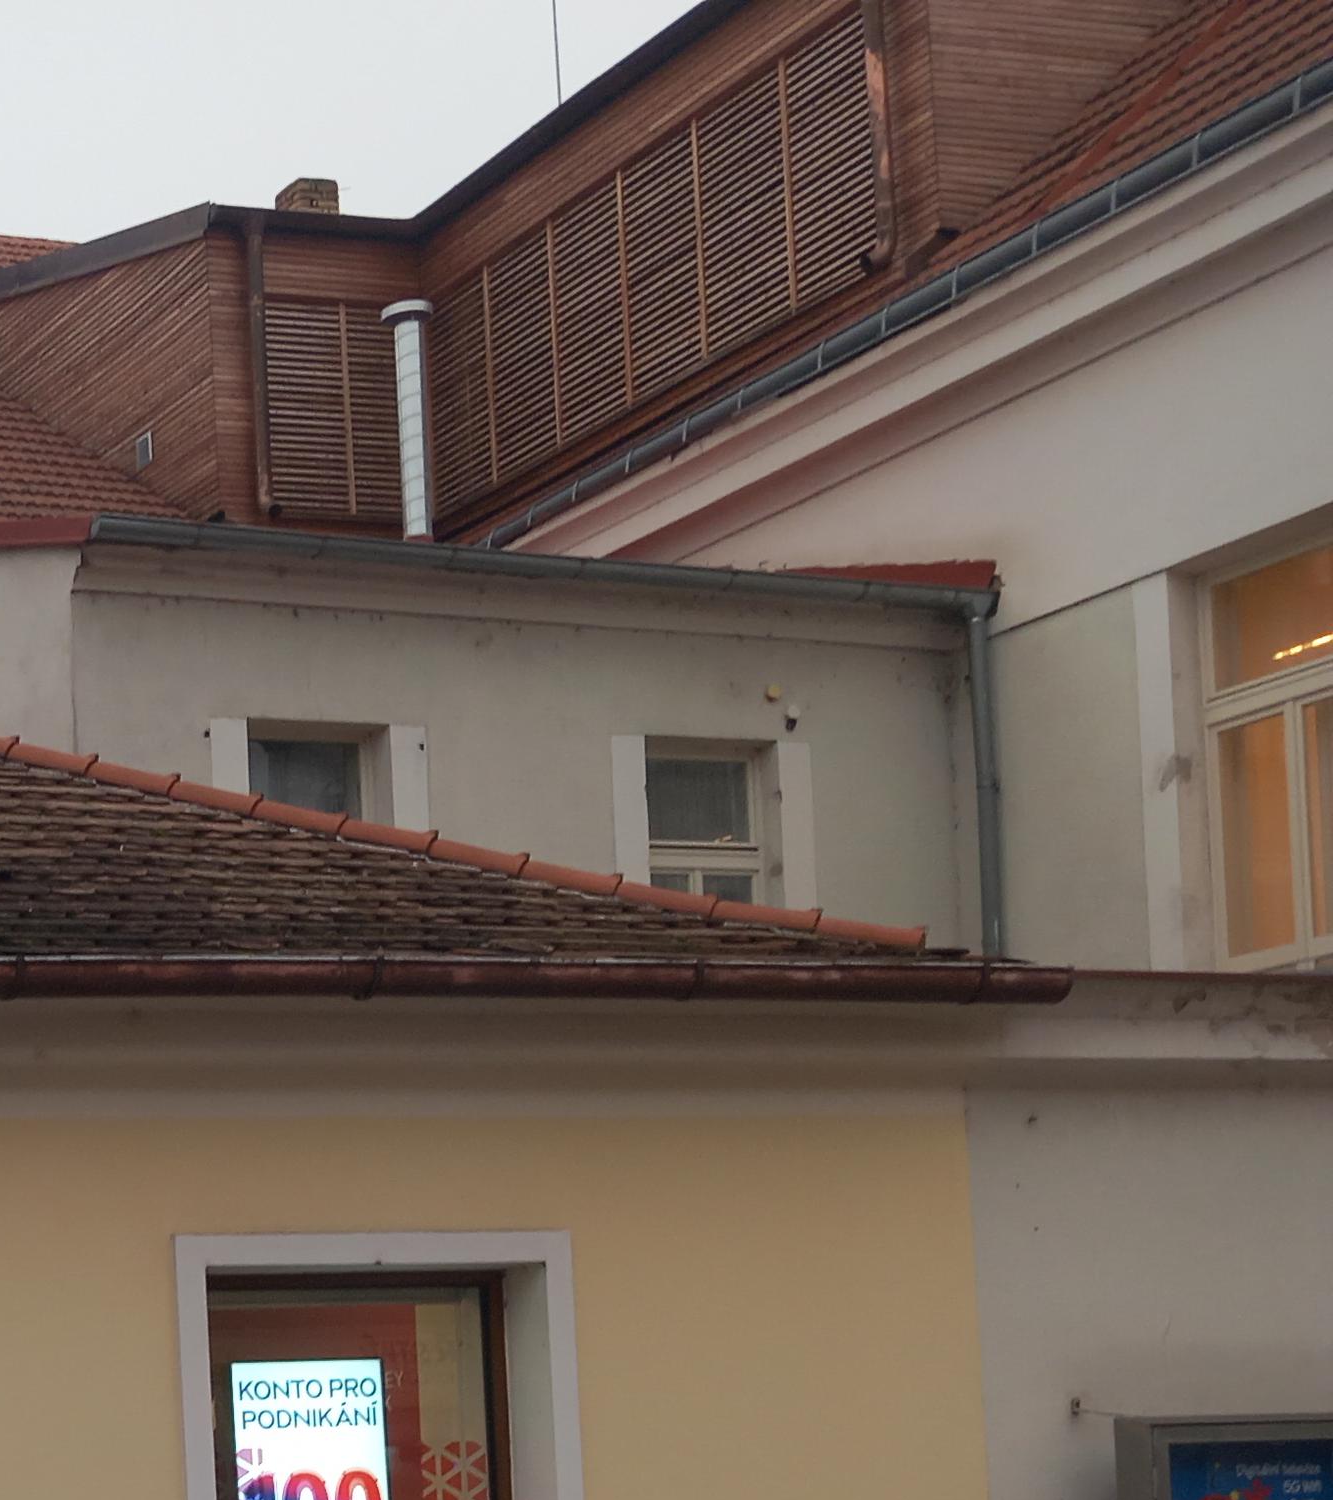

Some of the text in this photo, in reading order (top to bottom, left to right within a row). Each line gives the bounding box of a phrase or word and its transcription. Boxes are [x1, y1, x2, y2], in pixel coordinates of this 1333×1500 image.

[238, 1379, 323, 1401] KONTO
[330, 1377, 377, 1399] PRO
[242, 1400, 378, 1430] PODNIKÁNÍ
